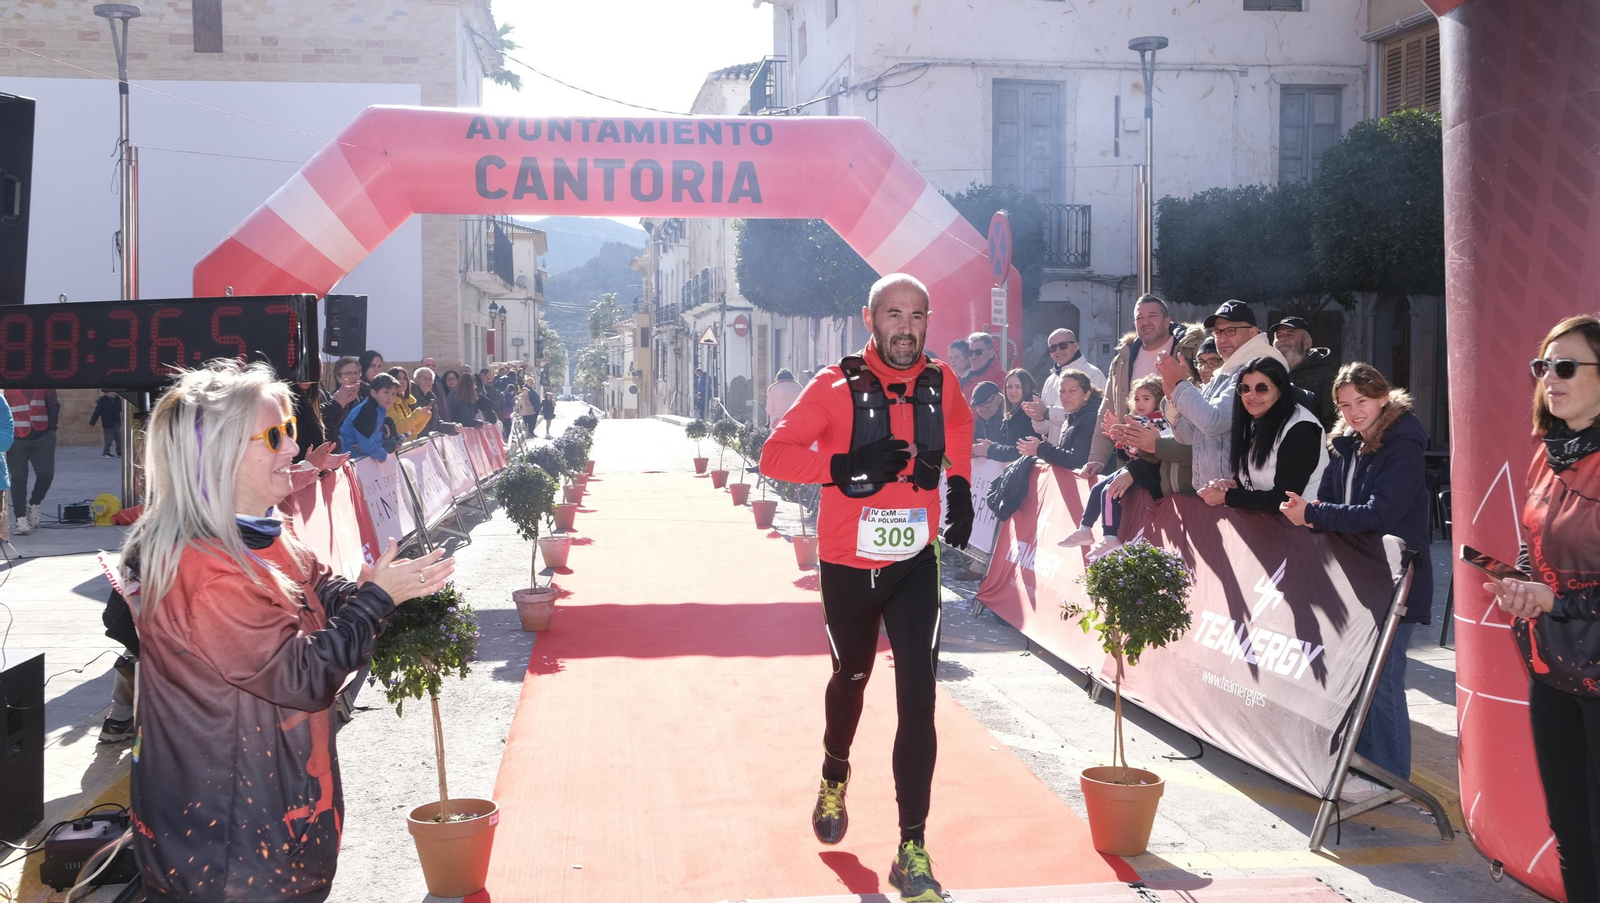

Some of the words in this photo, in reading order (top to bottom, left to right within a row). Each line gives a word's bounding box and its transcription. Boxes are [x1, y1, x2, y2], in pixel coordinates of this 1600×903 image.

[465, 114, 773, 146] AYUNTAMIENTO
[475, 154, 763, 204] CANTORIA
[873, 526, 915, 547] 309
[1192, 610, 1325, 680] TEAMERGY
[1202, 669, 1267, 707] www.teamergy.es
